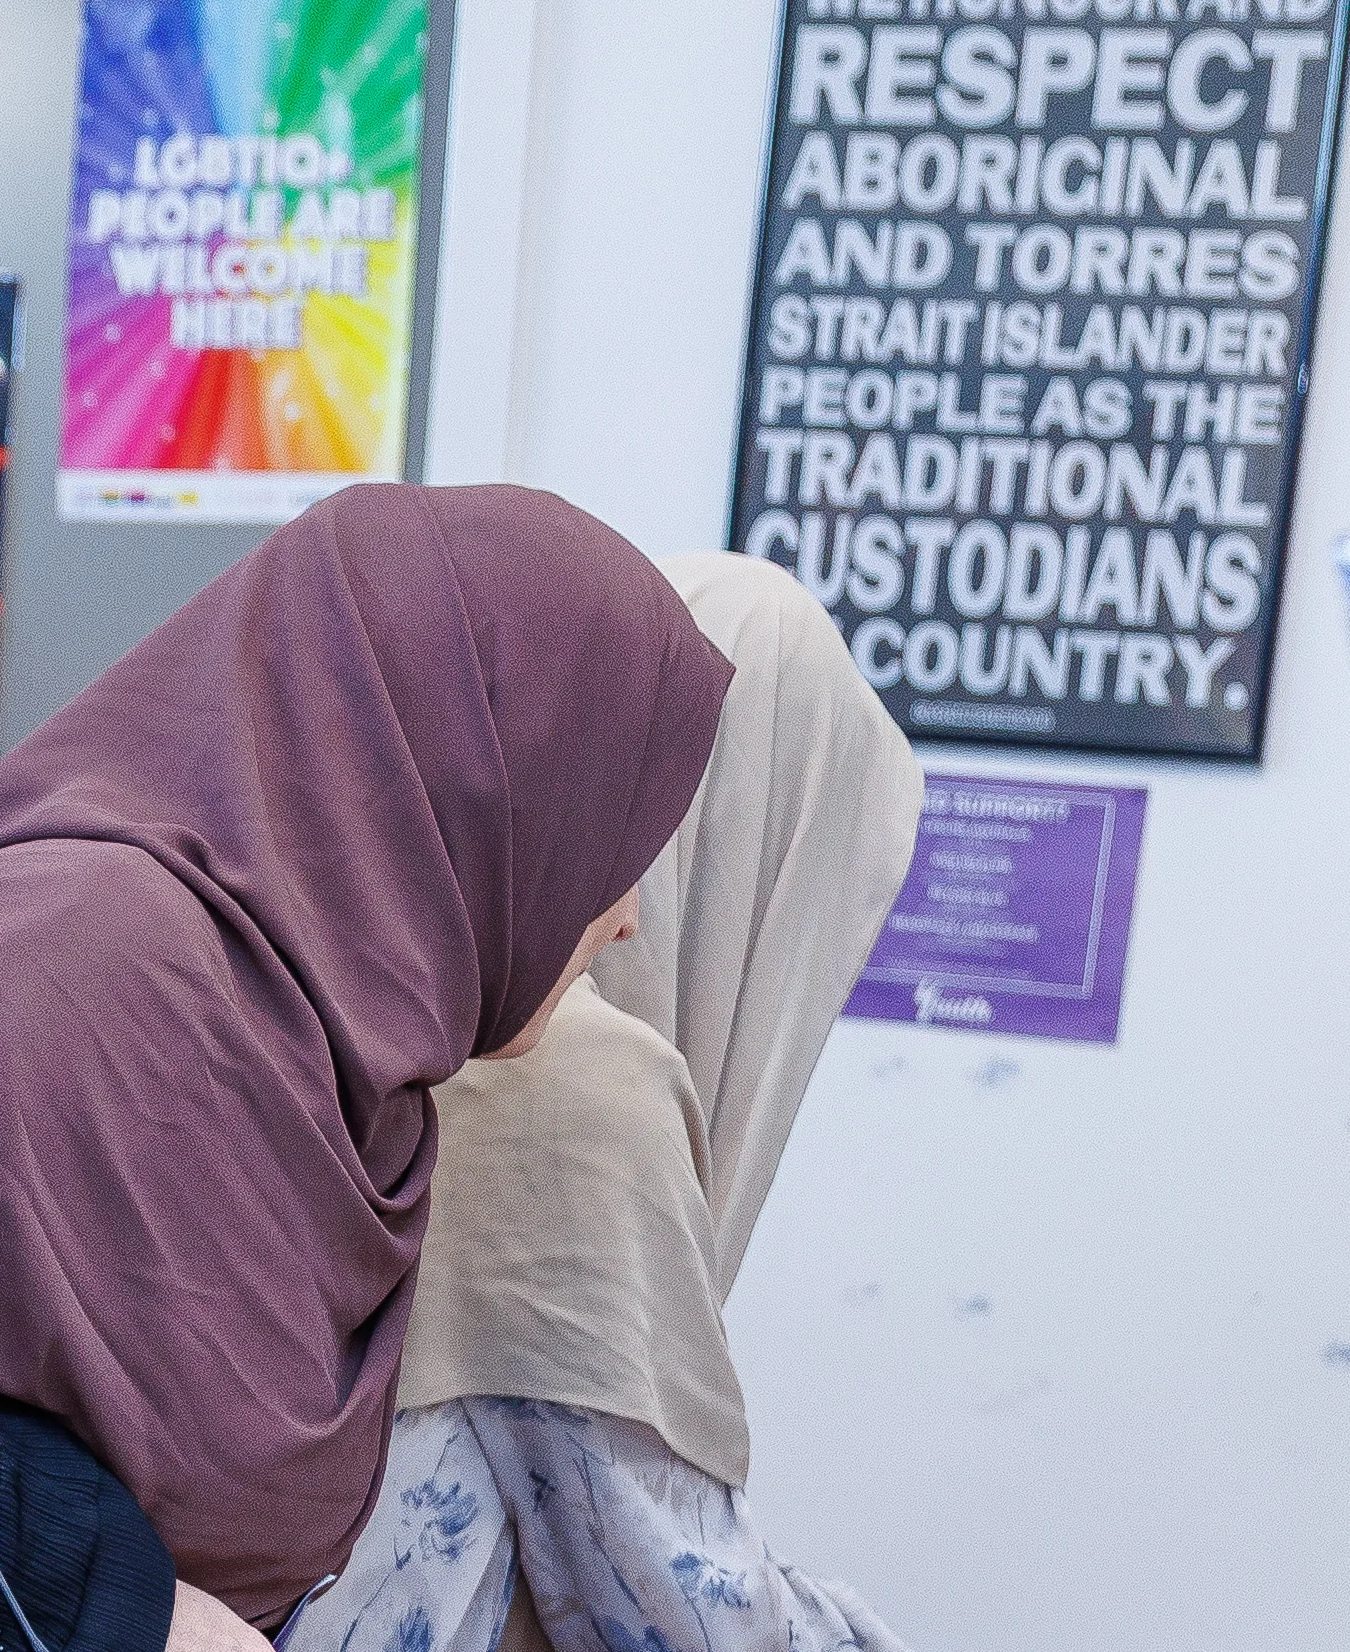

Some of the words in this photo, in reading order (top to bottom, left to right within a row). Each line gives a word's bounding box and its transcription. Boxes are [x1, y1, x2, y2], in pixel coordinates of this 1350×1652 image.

[788, 24, 1327, 133] RESPECT
[87, 188, 285, 243] PEOPLE
[293, 190, 397, 241] ARE
[781, 130, 1308, 220] ABORIGINAL
[111, 242, 368, 297] WELCOME
[774, 220, 953, 290] AND
[967, 224, 1301, 300] TORRES
[170, 296, 304, 350] HERE
[766, 295, 977, 366] STRAIT
[981, 300, 1290, 376] ISLANDER
[760, 366, 1030, 434] PEOPLE
[1032, 376, 1133, 440] AS
[1144, 380, 1286, 446] THE
[755, 430, 1270, 526] TRADITIONAL
[746, 507, 1261, 633] CUSTODIANS
[849, 616, 1250, 712] COUNTRY.
